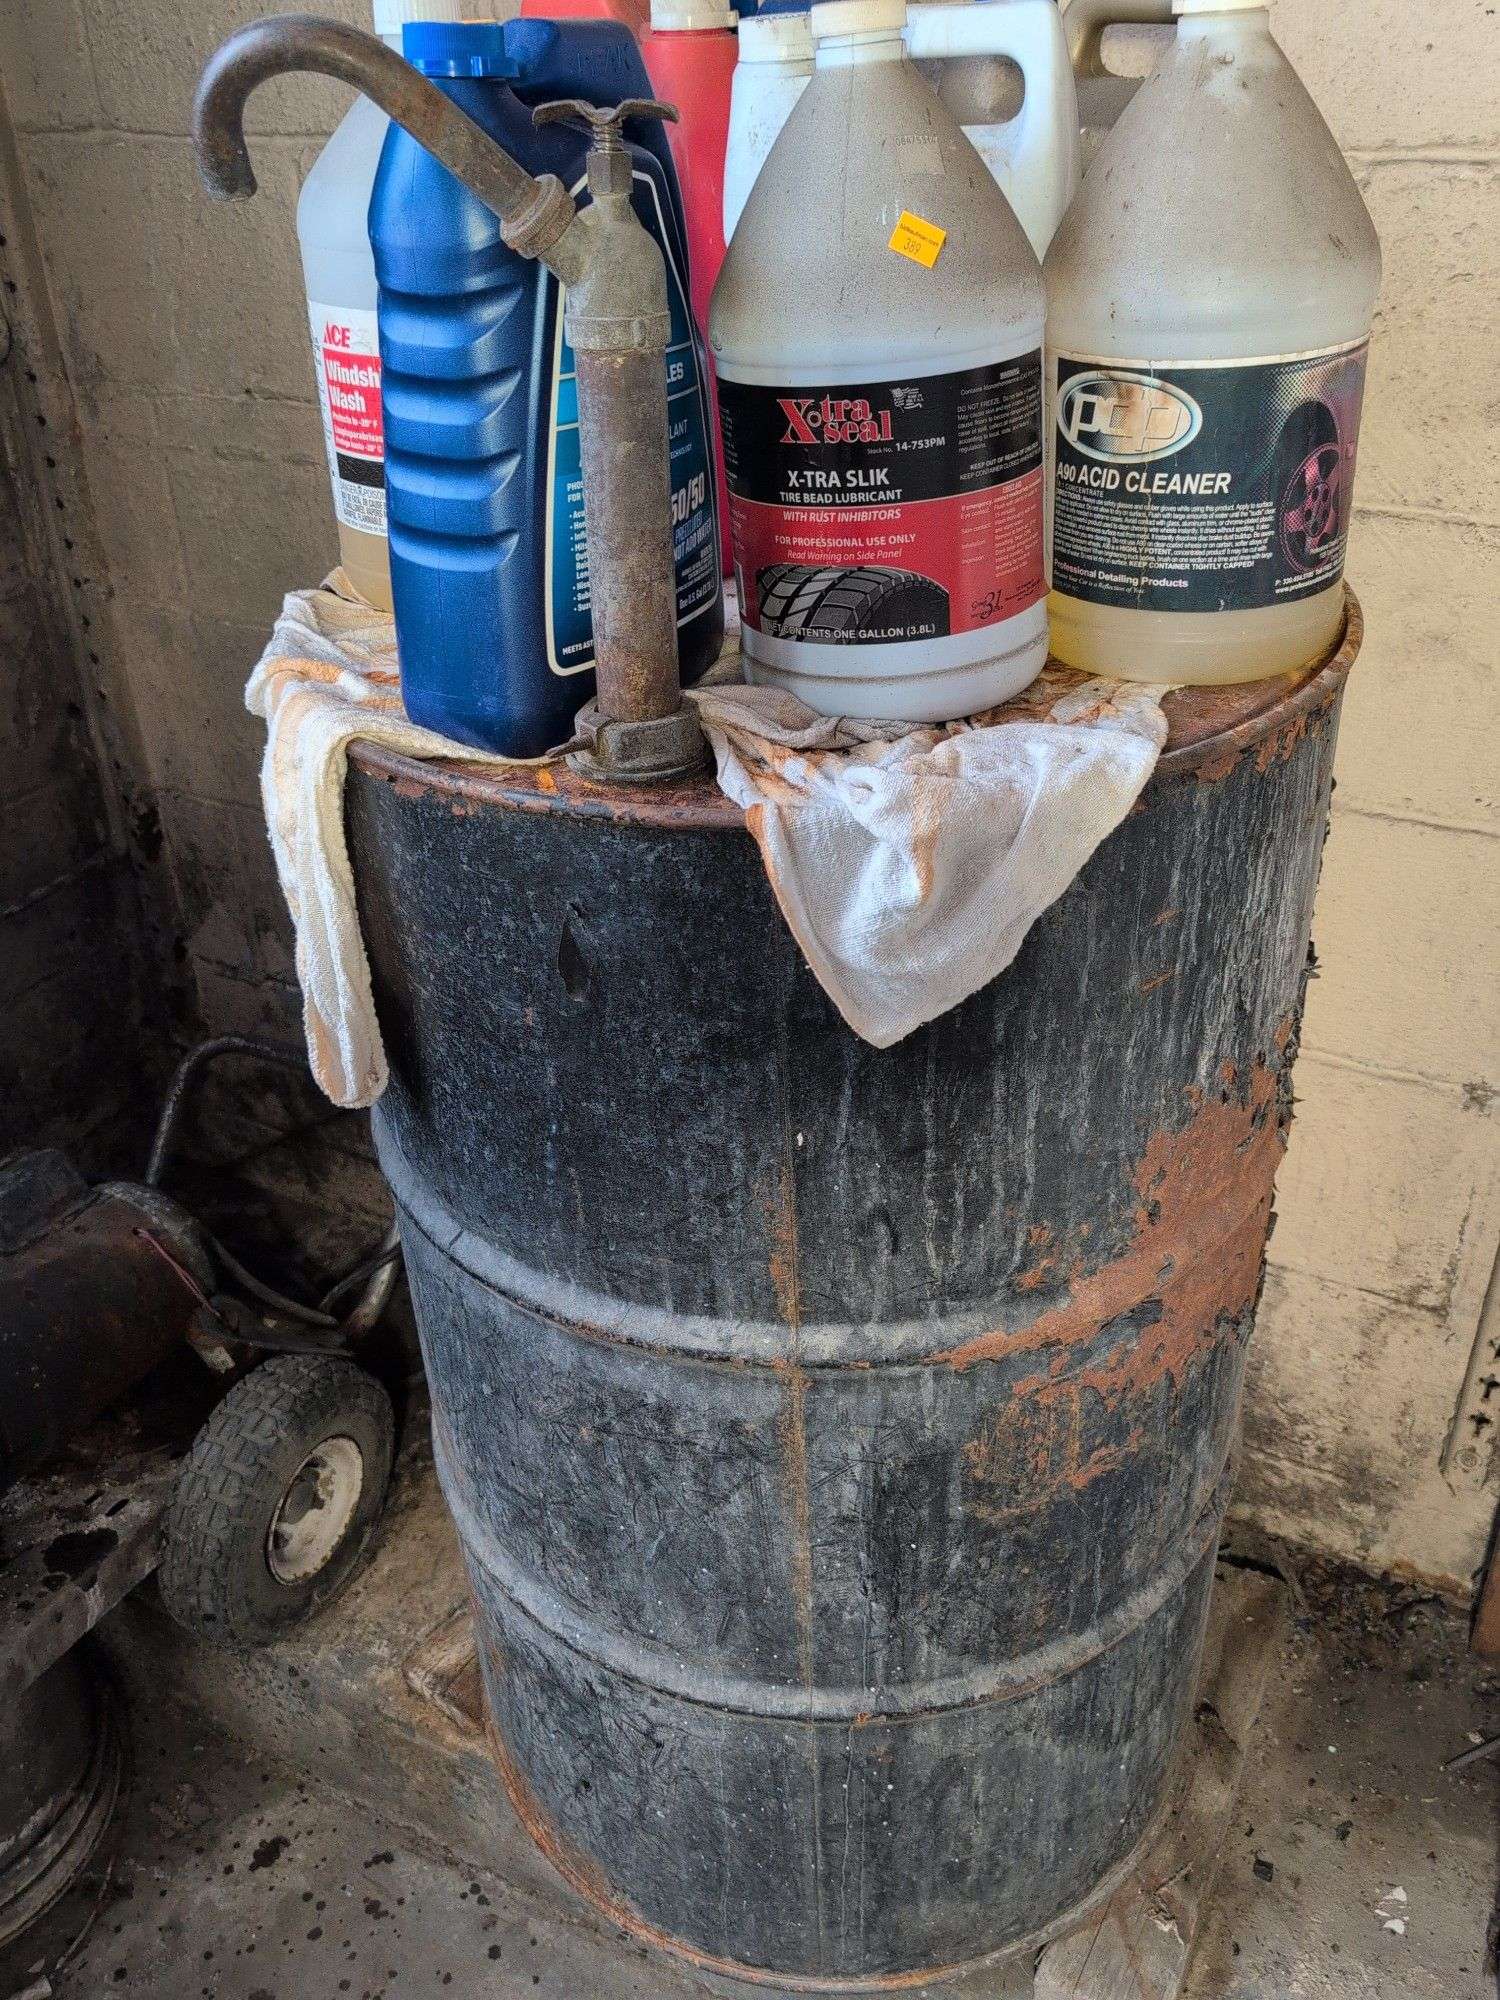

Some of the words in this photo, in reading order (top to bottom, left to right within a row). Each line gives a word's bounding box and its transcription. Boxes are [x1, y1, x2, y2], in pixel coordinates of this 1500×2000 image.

[323, 320, 351, 348] ACE
[330, 384, 366, 413] Wash
[823, 410, 894, 445] seal
[895, 436, 946, 452] 14-753PM
[787, 470, 842, 489] X-TRA
[846, 467, 890, 488] SLIK
[1056, 461, 1077, 482] A90
[1078, 464, 1120, 491] ACID
[1125, 471, 1232, 495] CLEANER
[671, 472, 705, 526] 50/50
[780, 491, 800, 503] TIRE
[801, 491, 831, 503] BEAD
[833, 489, 903, 503] LUBRICANT
[783, 510, 808, 522] WITH
[809, 510, 836, 522] RUST
[837, 508, 902, 521] INHIBITORS
[775, 535, 792, 544] FOR
[792, 535, 864, 547] PROFESSIONAL
[866, 535, 885, 546] USE
[887, 533, 916, 544] ONLY
[787, 549, 804, 559] Read
[805, 550, 842, 562] Warning
[843, 552, 854, 560] on
[855, 550, 872, 559] Side
[874, 548, 902, 559] Panel
[1149, 561, 1190, 571] CONTAINER
[1192, 562, 1222, 571] TIGHTLY
[1098, 570, 1140, 586] Detailing
[1141, 576, 1189, 589] Products
[783, 624, 831, 638] CONTENTS
[833, 629, 856, 639] ONE
[858, 627, 904, 639] GALLON
[906, 623, 936, 638] (3.8L)
